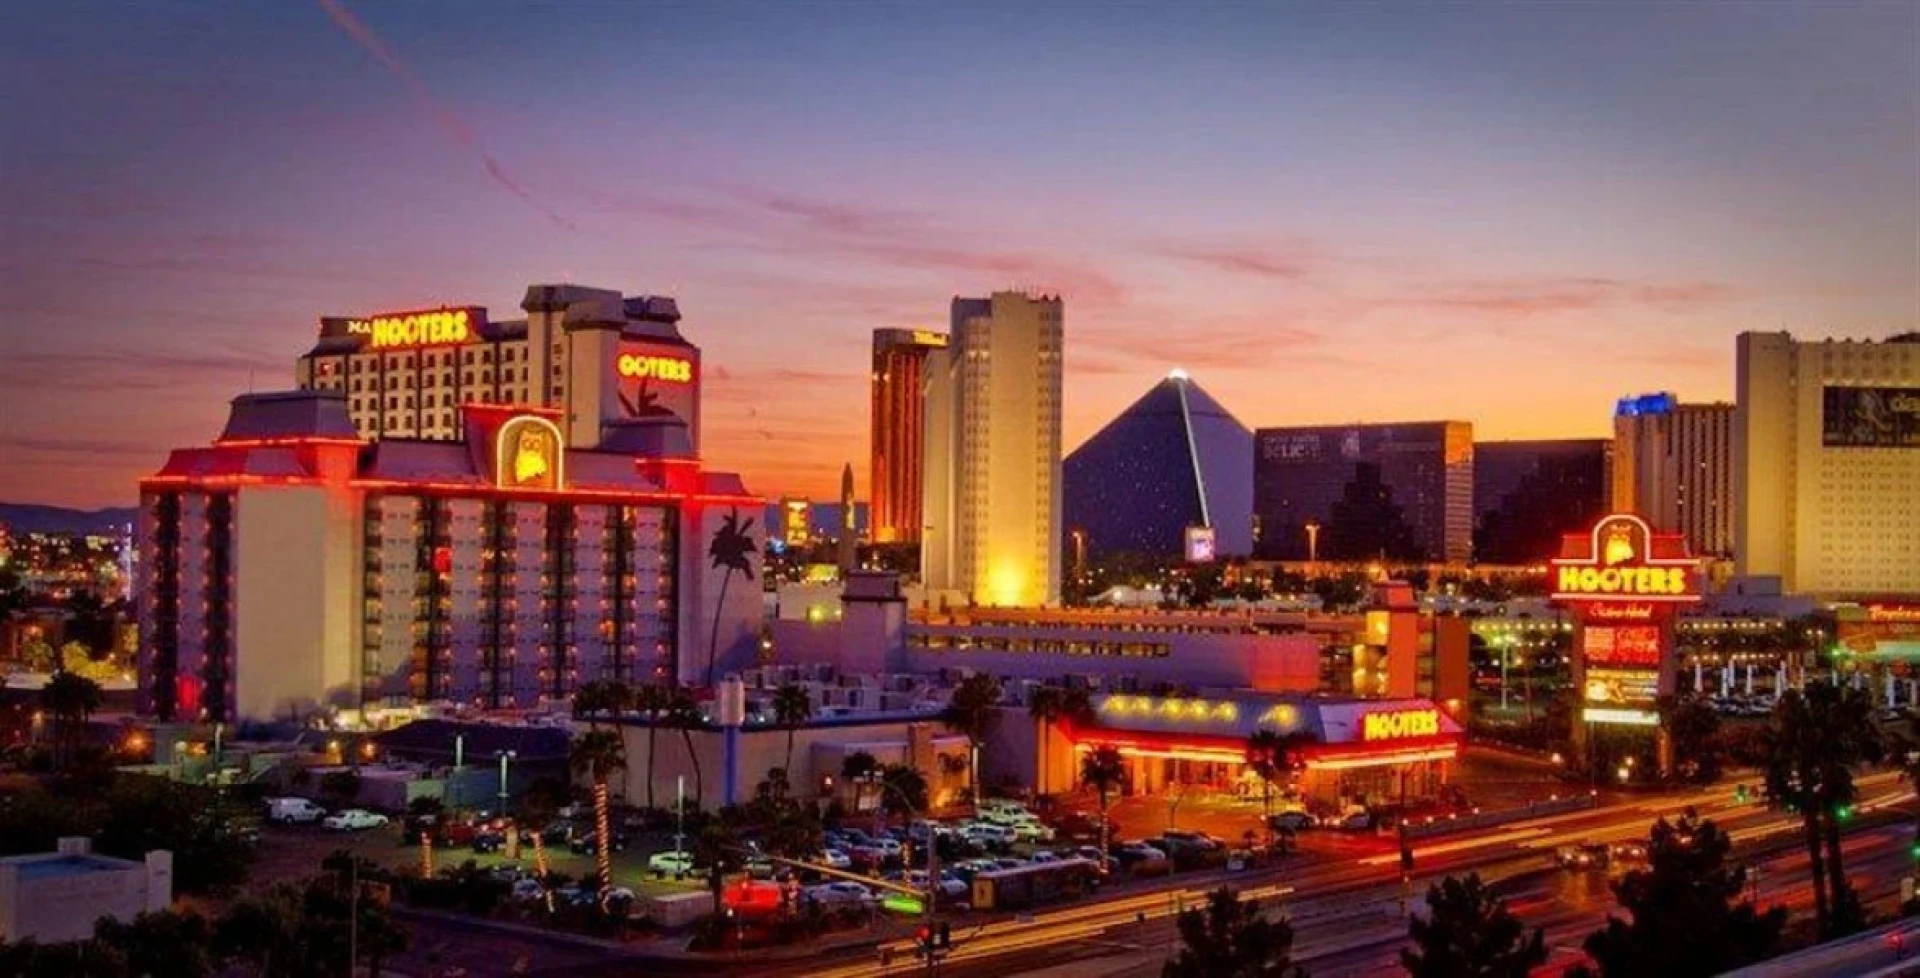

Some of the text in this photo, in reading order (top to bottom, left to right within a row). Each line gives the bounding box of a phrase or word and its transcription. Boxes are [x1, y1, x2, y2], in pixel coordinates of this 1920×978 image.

[372, 310, 468, 347] HOOTERS
[1559, 567, 1685, 594] HOOTERS
[1364, 709, 1438, 740] HOOTERS
